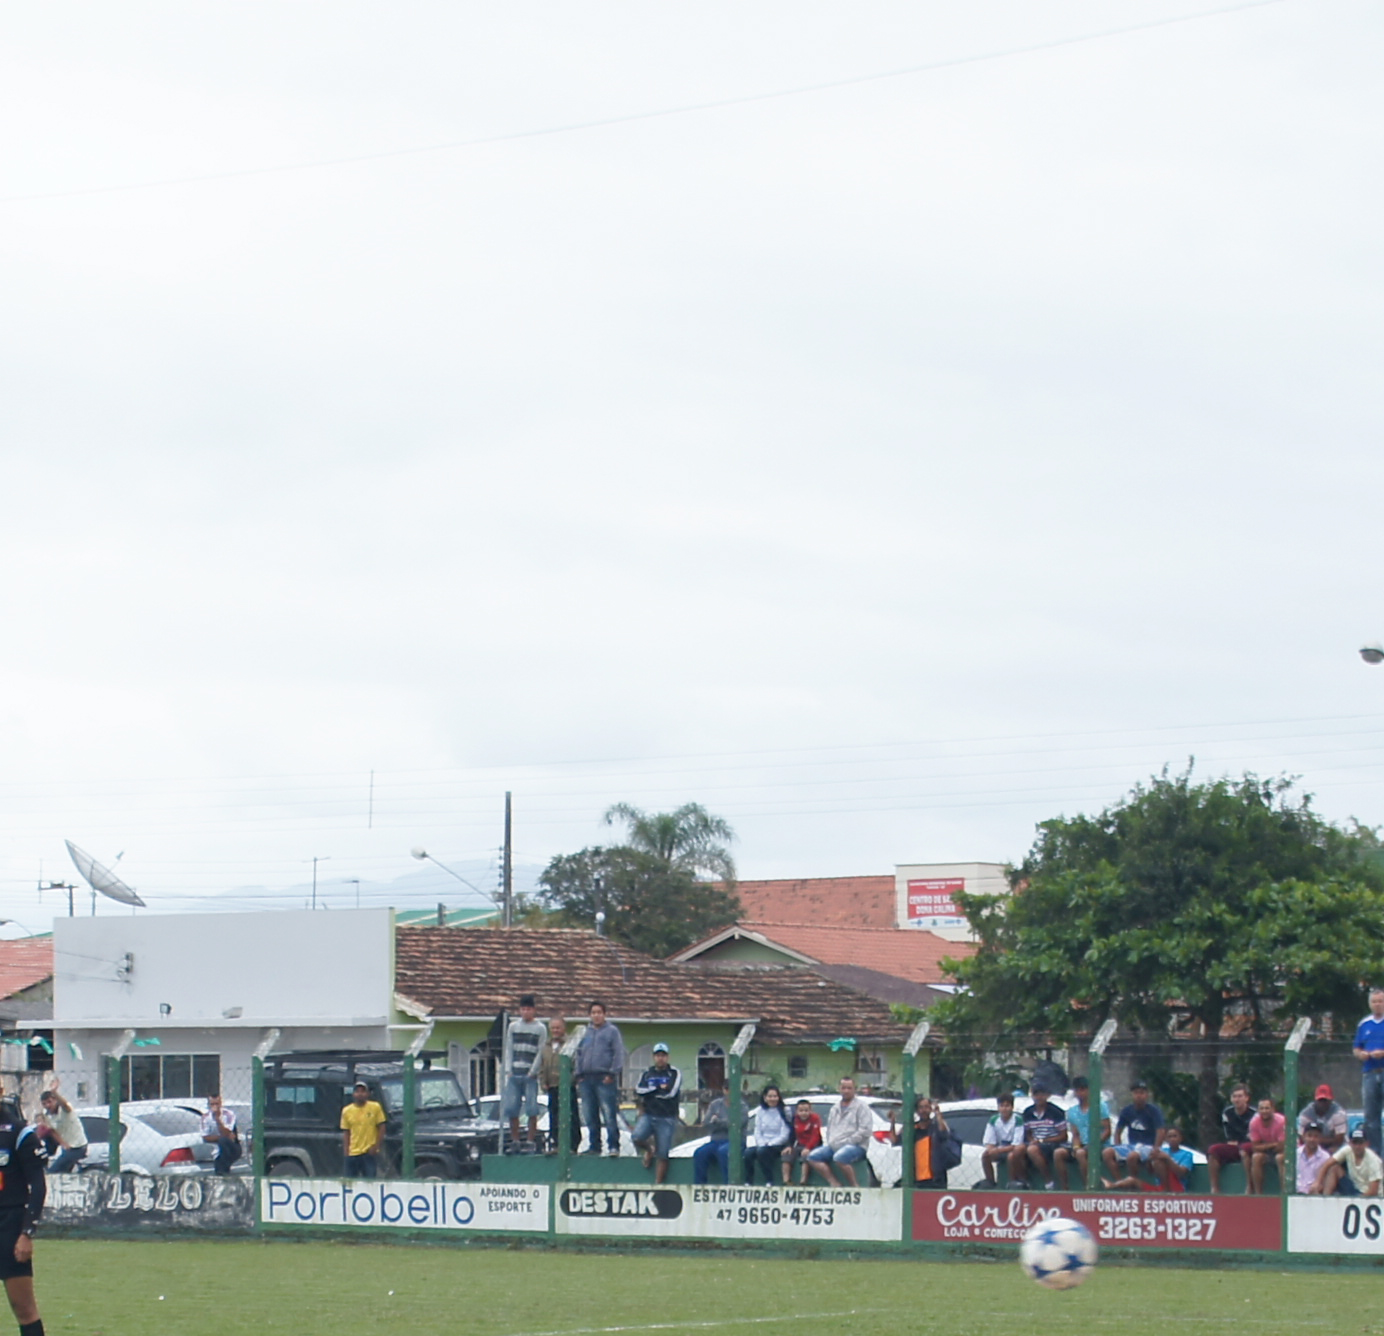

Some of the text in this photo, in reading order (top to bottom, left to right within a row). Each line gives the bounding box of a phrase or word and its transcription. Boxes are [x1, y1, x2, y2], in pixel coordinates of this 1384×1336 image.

[479, 1187, 540, 1199] APOIANDO O
[693, 1188, 779, 1204] ESTRUTURAS
[268, 1182, 475, 1225] Portobello
[488, 1200, 533, 1213] ESPORTE
[568, 1191, 659, 1216] DESTAK
[1072, 1198, 1214, 1214] UNIFORMES ESPORTIVOS
[716, 1207, 835, 1226] 47 9650-4753
[943, 1227, 970, 1238] LOJA
[1099, 1216, 1217, 1242] 3263-1327
